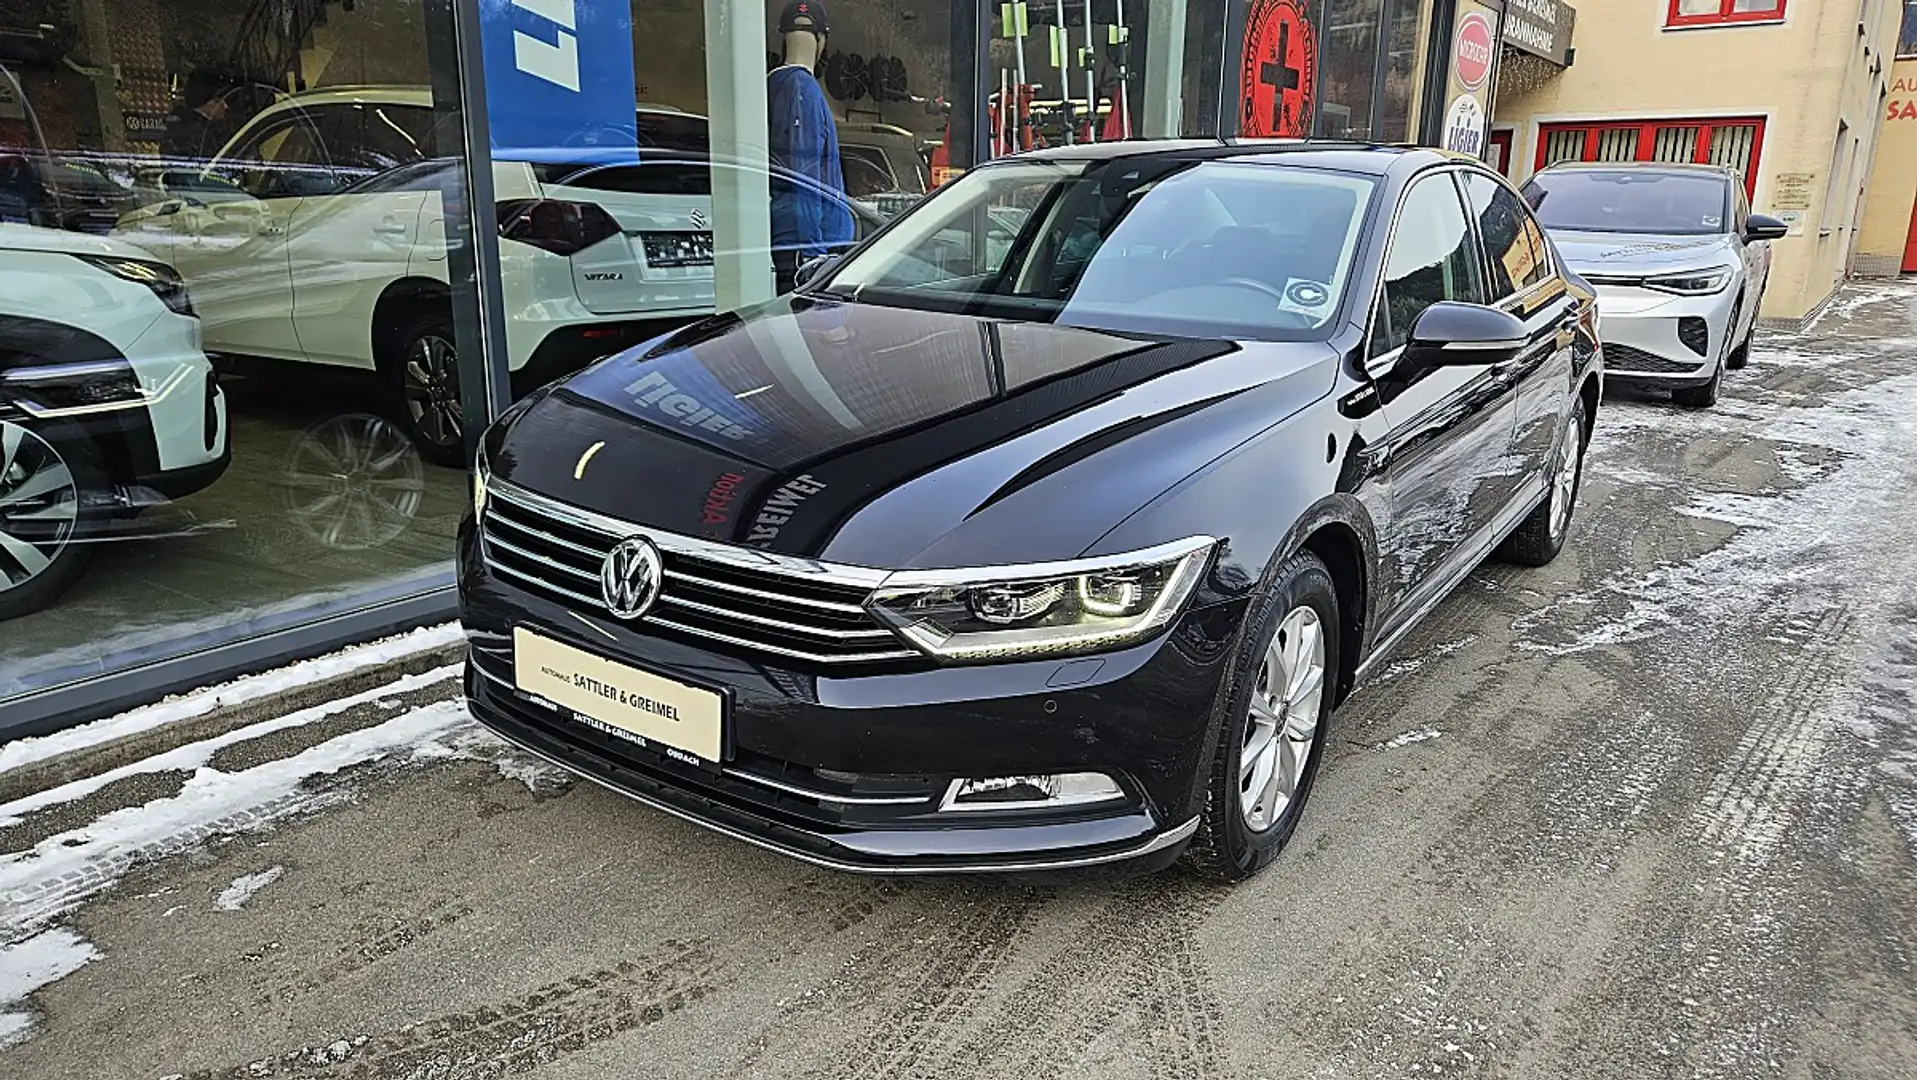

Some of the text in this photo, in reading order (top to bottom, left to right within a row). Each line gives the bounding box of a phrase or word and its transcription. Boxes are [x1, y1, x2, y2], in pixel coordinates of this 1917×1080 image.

[584, 273, 623, 281] VITARA
[573, 672, 618, 701] SATTLER
[619, 690, 628, 704] &
[629, 693, 681, 722] GREIMEL
[573, 712, 605, 731] SATTLER
[612, 728, 647, 748] GREIMEL
